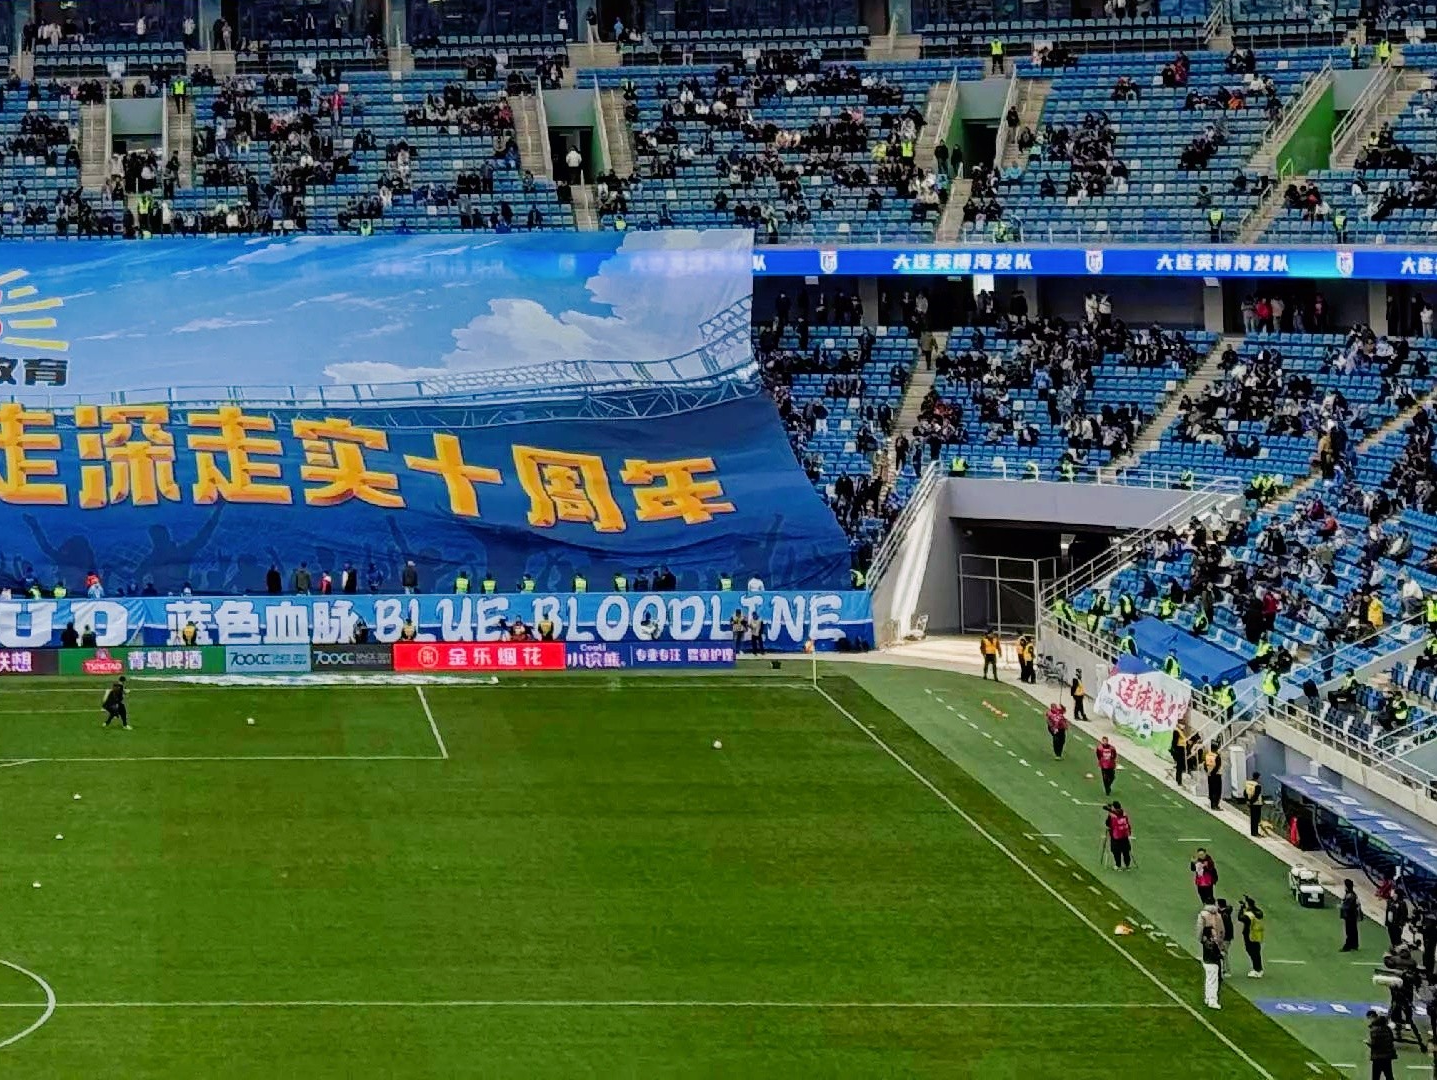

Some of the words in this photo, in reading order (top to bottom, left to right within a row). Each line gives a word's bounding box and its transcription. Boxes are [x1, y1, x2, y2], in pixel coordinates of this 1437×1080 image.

[893, 254, 1033, 271] 大连英博海发队
[1157, 254, 1288, 272] 大连英博海发队
[1401, 256, 1437, 274] 大连
[166, 599, 358, 645] 蓝色血脉
[373, 594, 510, 643] BLUE
[534, 593, 847, 643] BLOODLINE
[128, 651, 202, 670] 青岛啤酒
[448, 647, 543, 666] 金乐烟花
